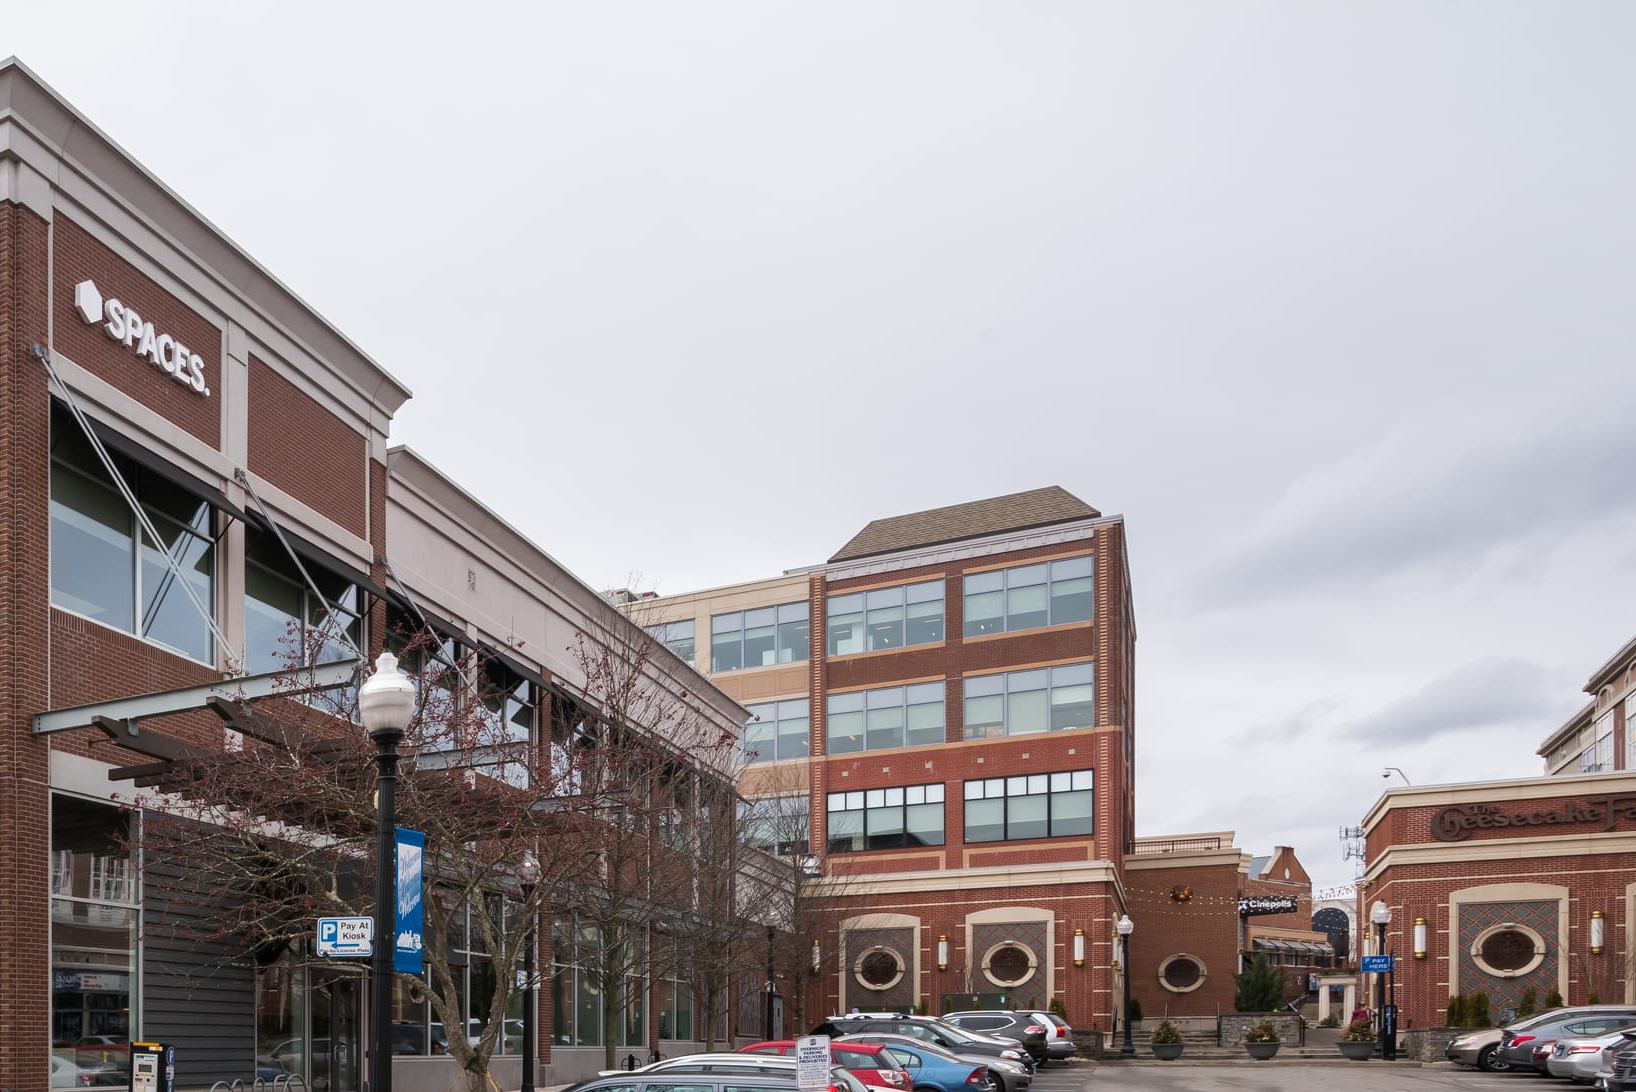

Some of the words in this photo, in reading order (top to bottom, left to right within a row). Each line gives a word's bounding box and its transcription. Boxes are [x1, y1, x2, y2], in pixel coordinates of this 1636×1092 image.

[104, 298, 210, 397] SPACES.
[1469, 805, 1500, 815] The
[1431, 799, 1600, 842] Cheesecake
[341, 922, 356, 931] Pay
[359, 922, 369, 930] At
[343, 932, 366, 940] Kiosk
